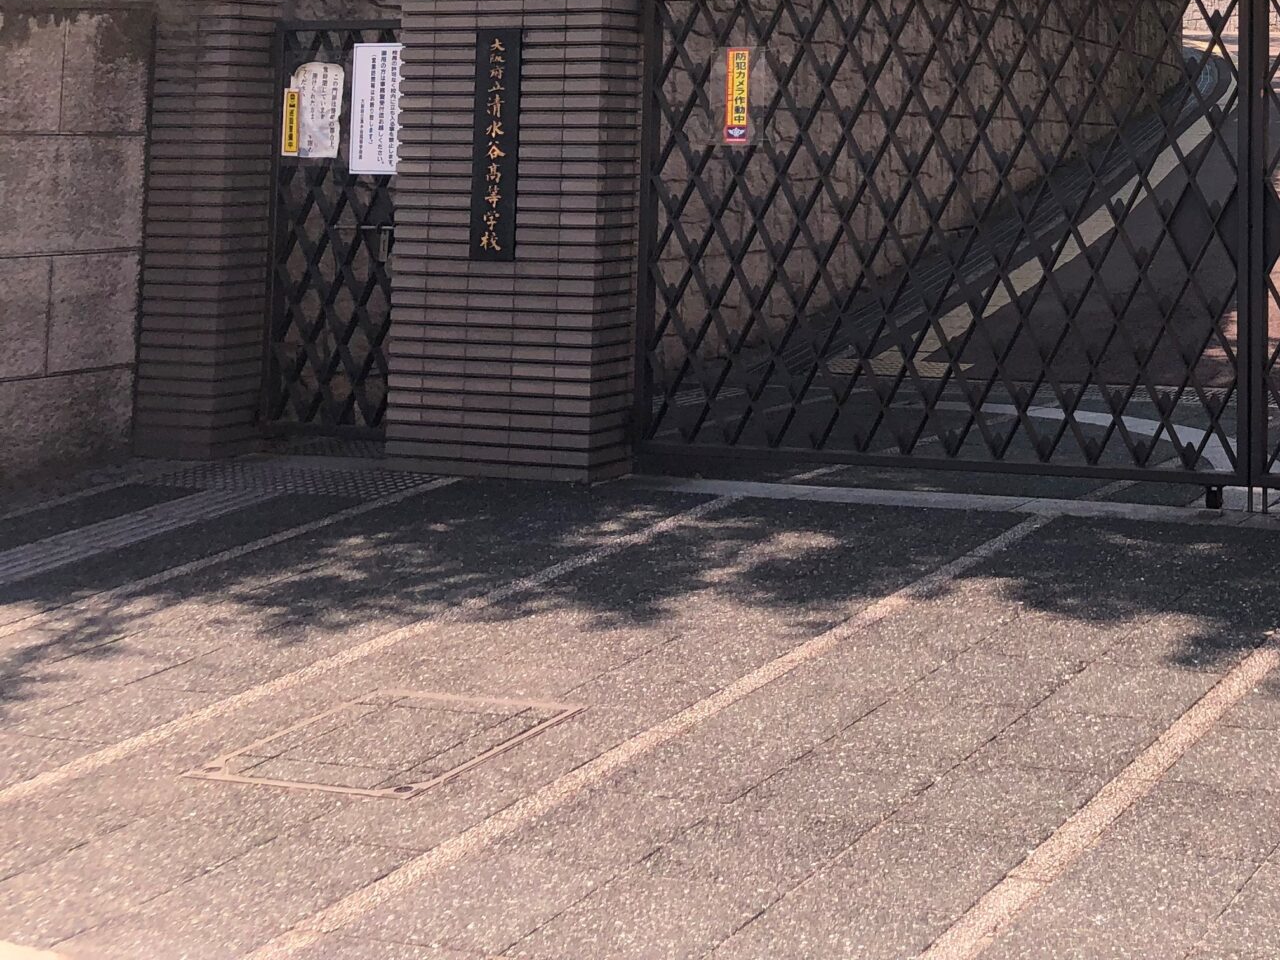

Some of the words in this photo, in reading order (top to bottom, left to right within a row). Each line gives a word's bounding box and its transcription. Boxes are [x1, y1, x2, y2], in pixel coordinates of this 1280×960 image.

[734, 52, 746, 123] 防犯カメラ作動中
